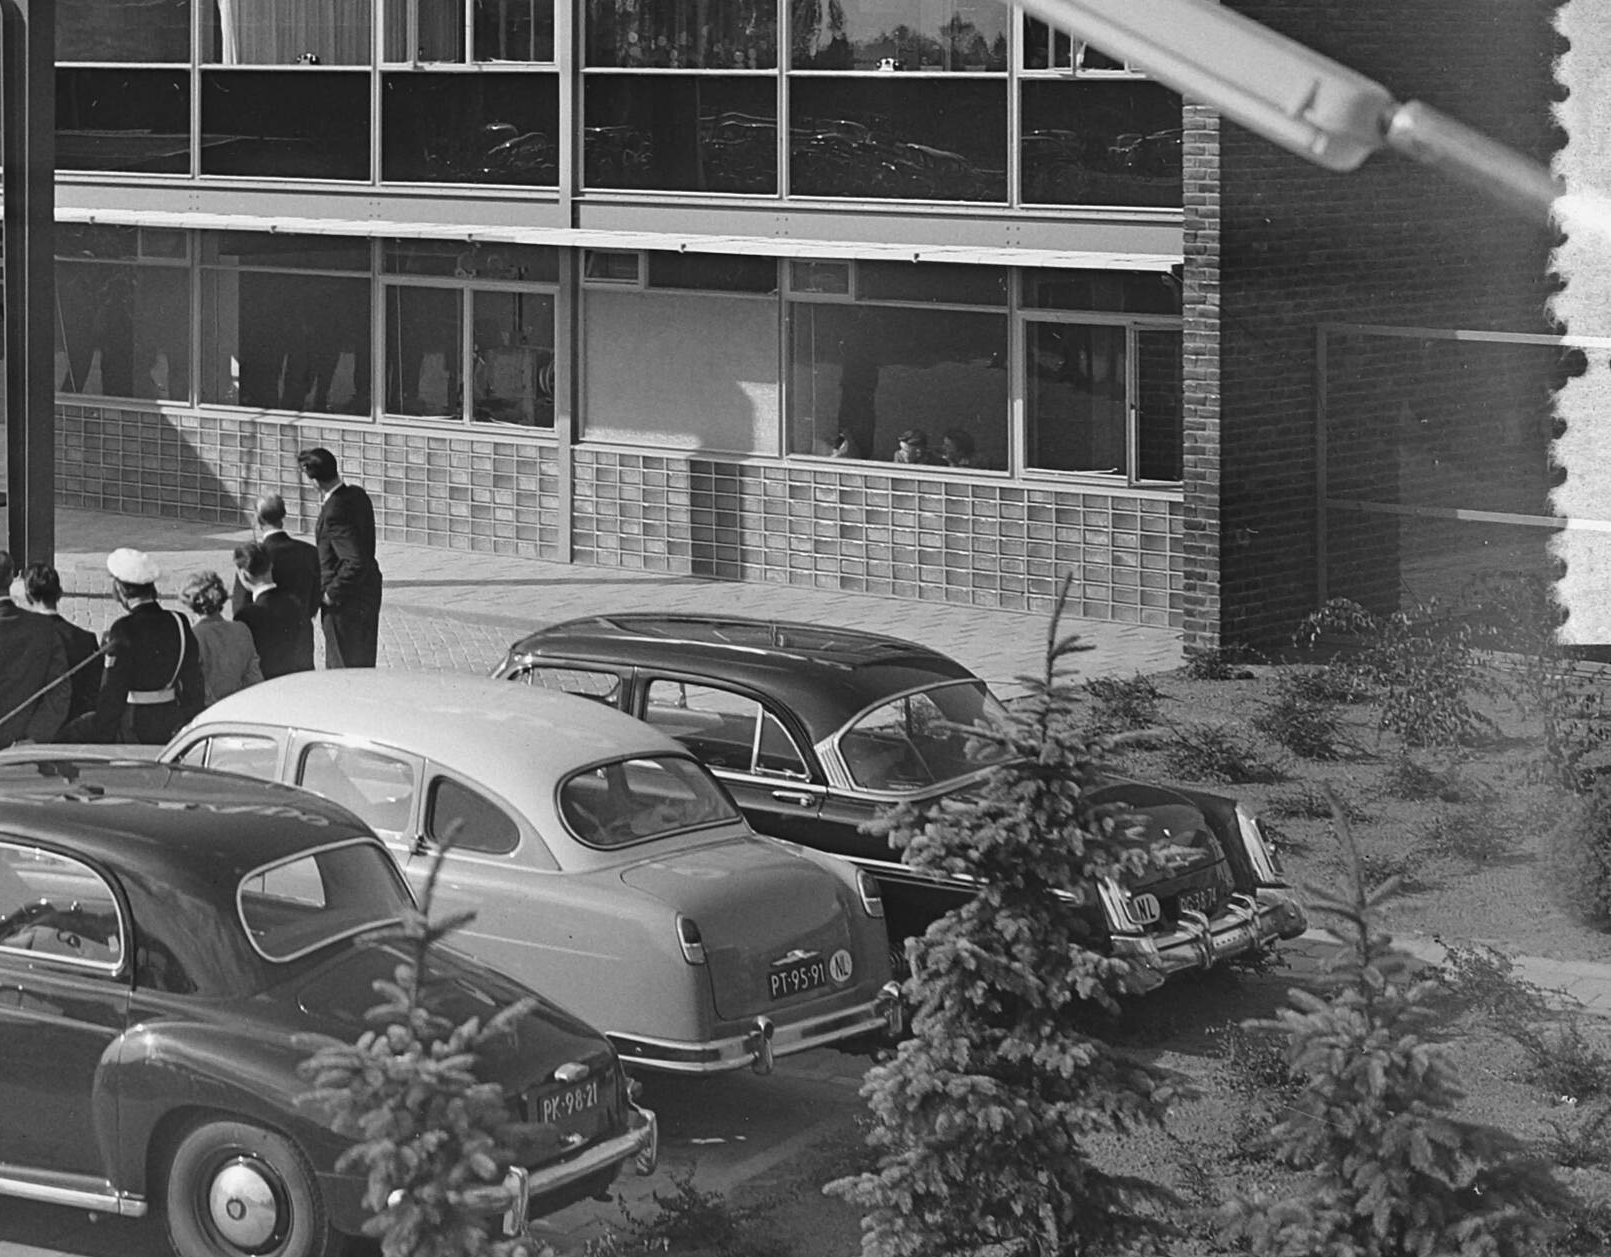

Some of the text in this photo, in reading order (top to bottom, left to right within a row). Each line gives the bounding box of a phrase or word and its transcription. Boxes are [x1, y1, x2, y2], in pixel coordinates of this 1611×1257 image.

[1135, 897, 1157, 922] NL
[833, 955, 850, 978] NL
[770, 962, 826, 997] PT-95-91
